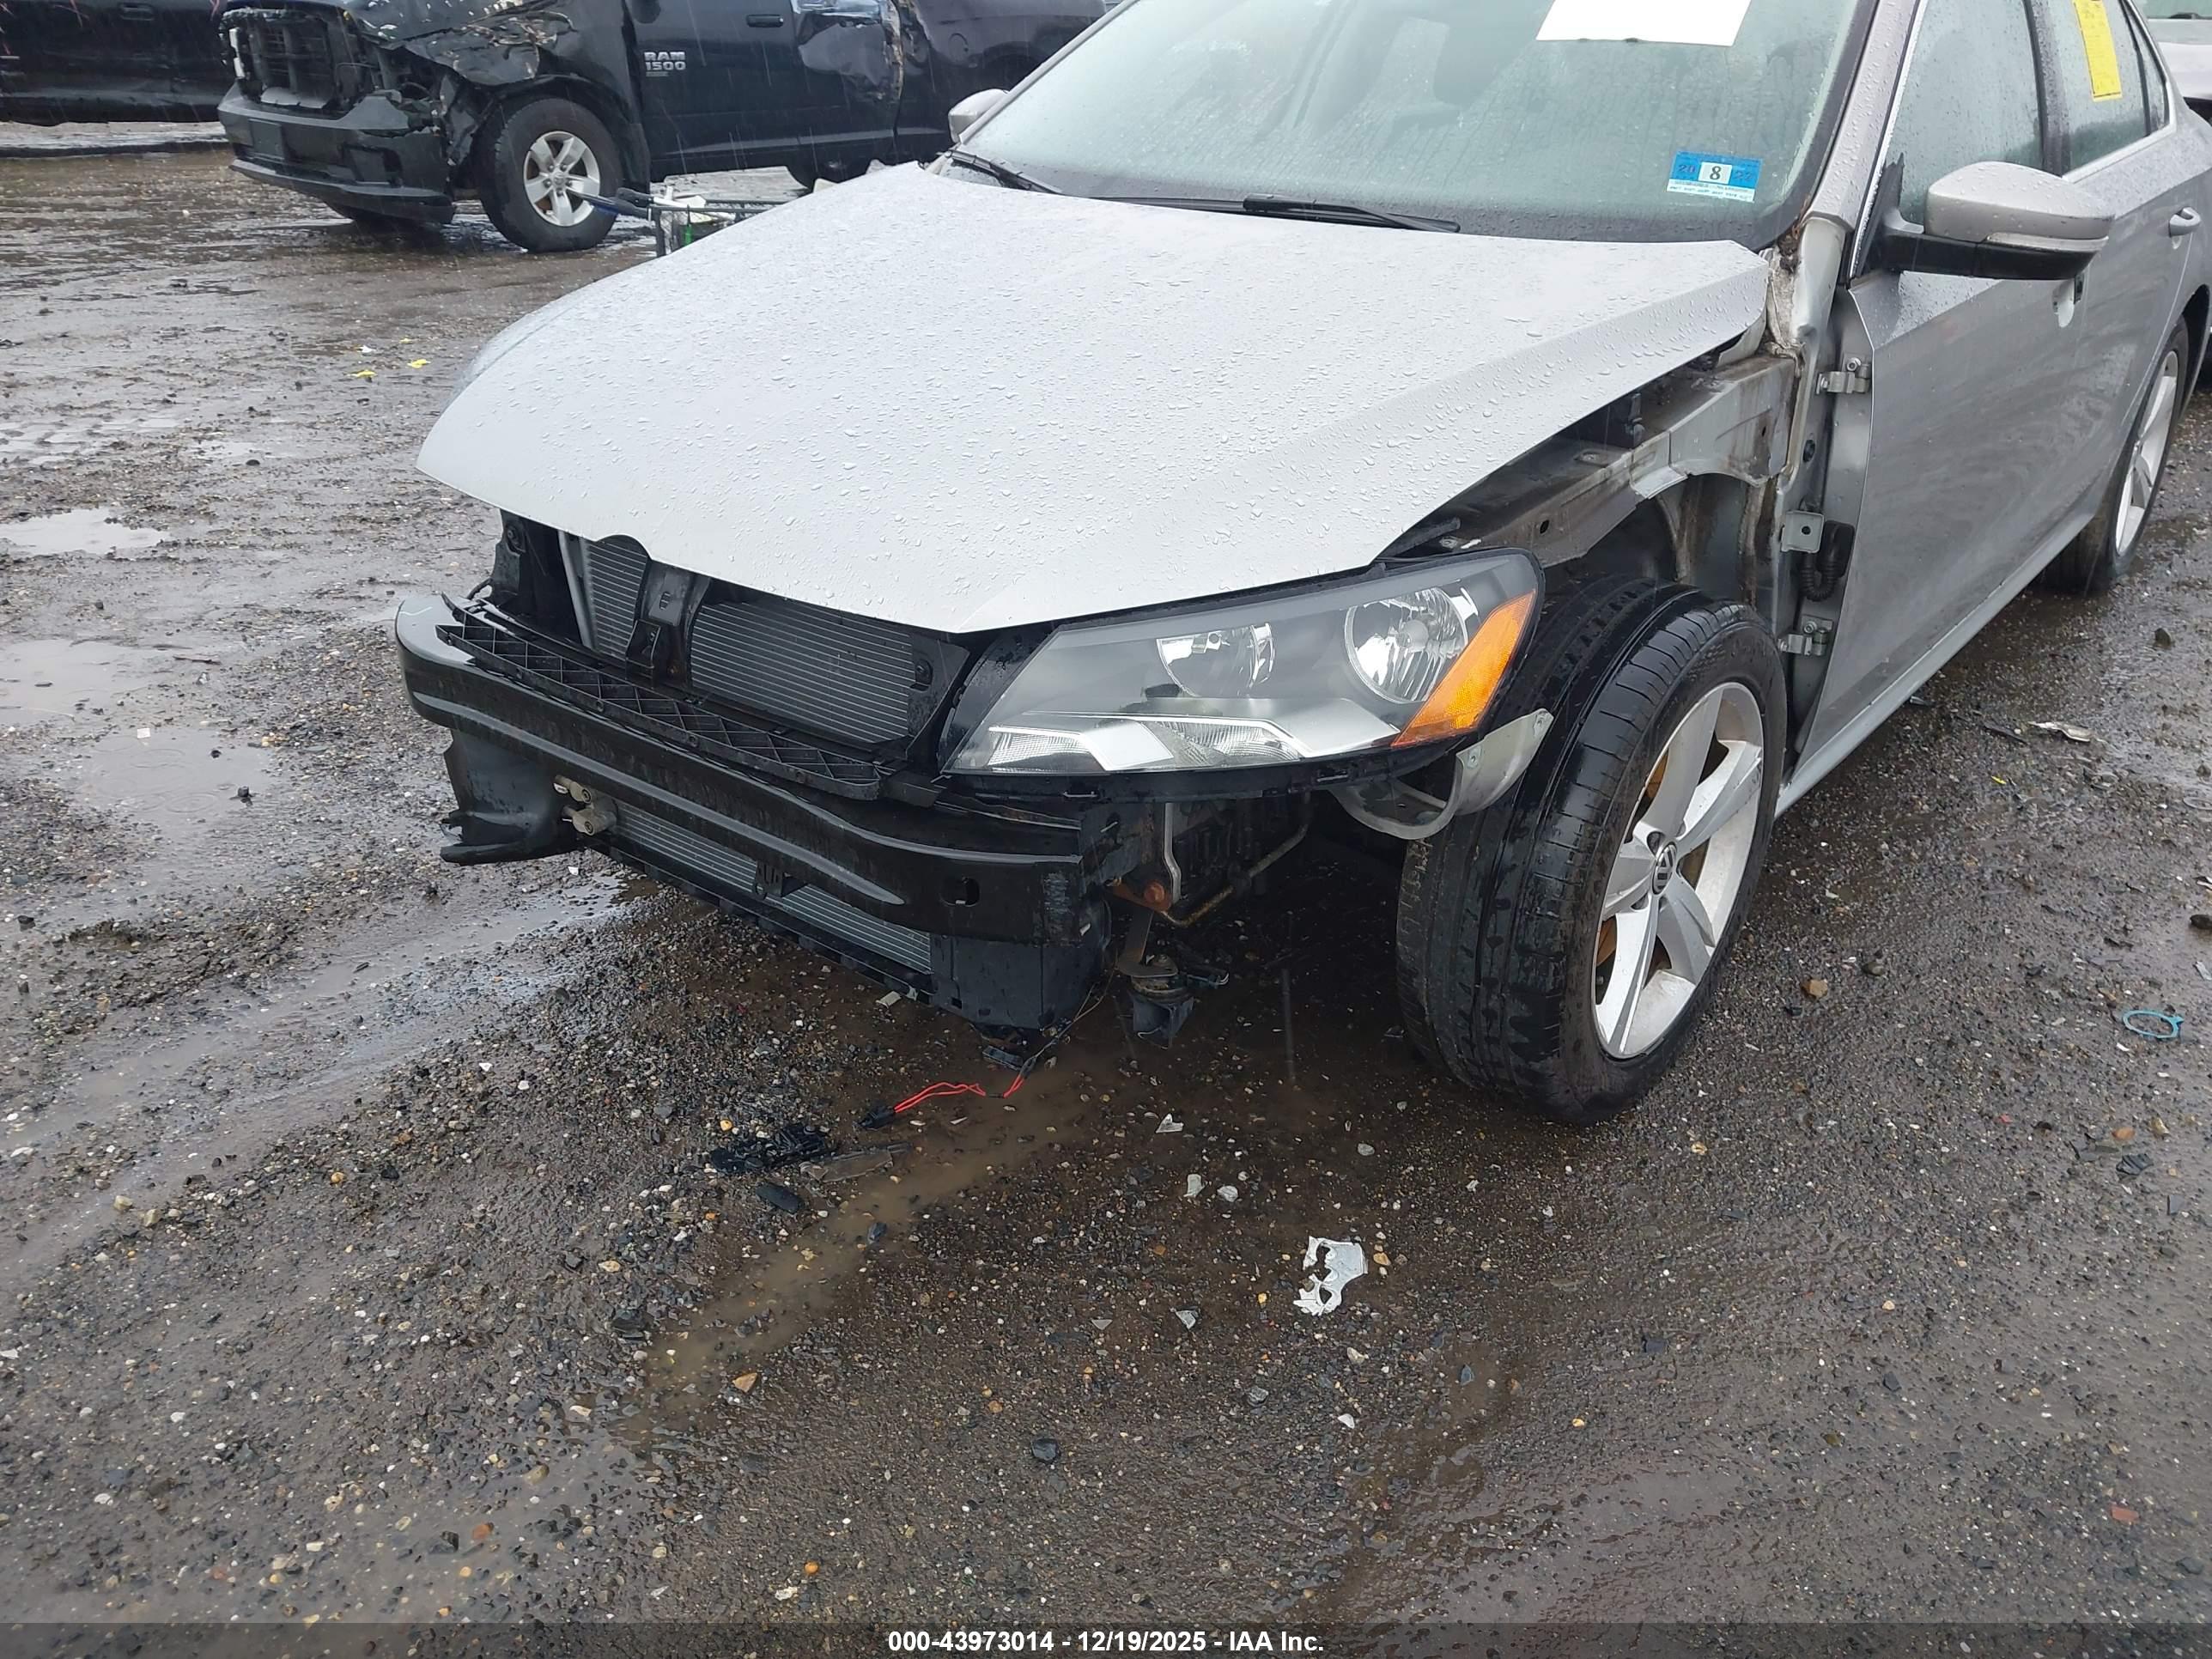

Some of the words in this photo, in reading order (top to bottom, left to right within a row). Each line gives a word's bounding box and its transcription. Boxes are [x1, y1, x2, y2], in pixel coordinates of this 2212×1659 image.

[644, 52, 685, 61] RAM
[645, 61, 686, 70] 1500
[1709, 166, 1722, 180] 8
